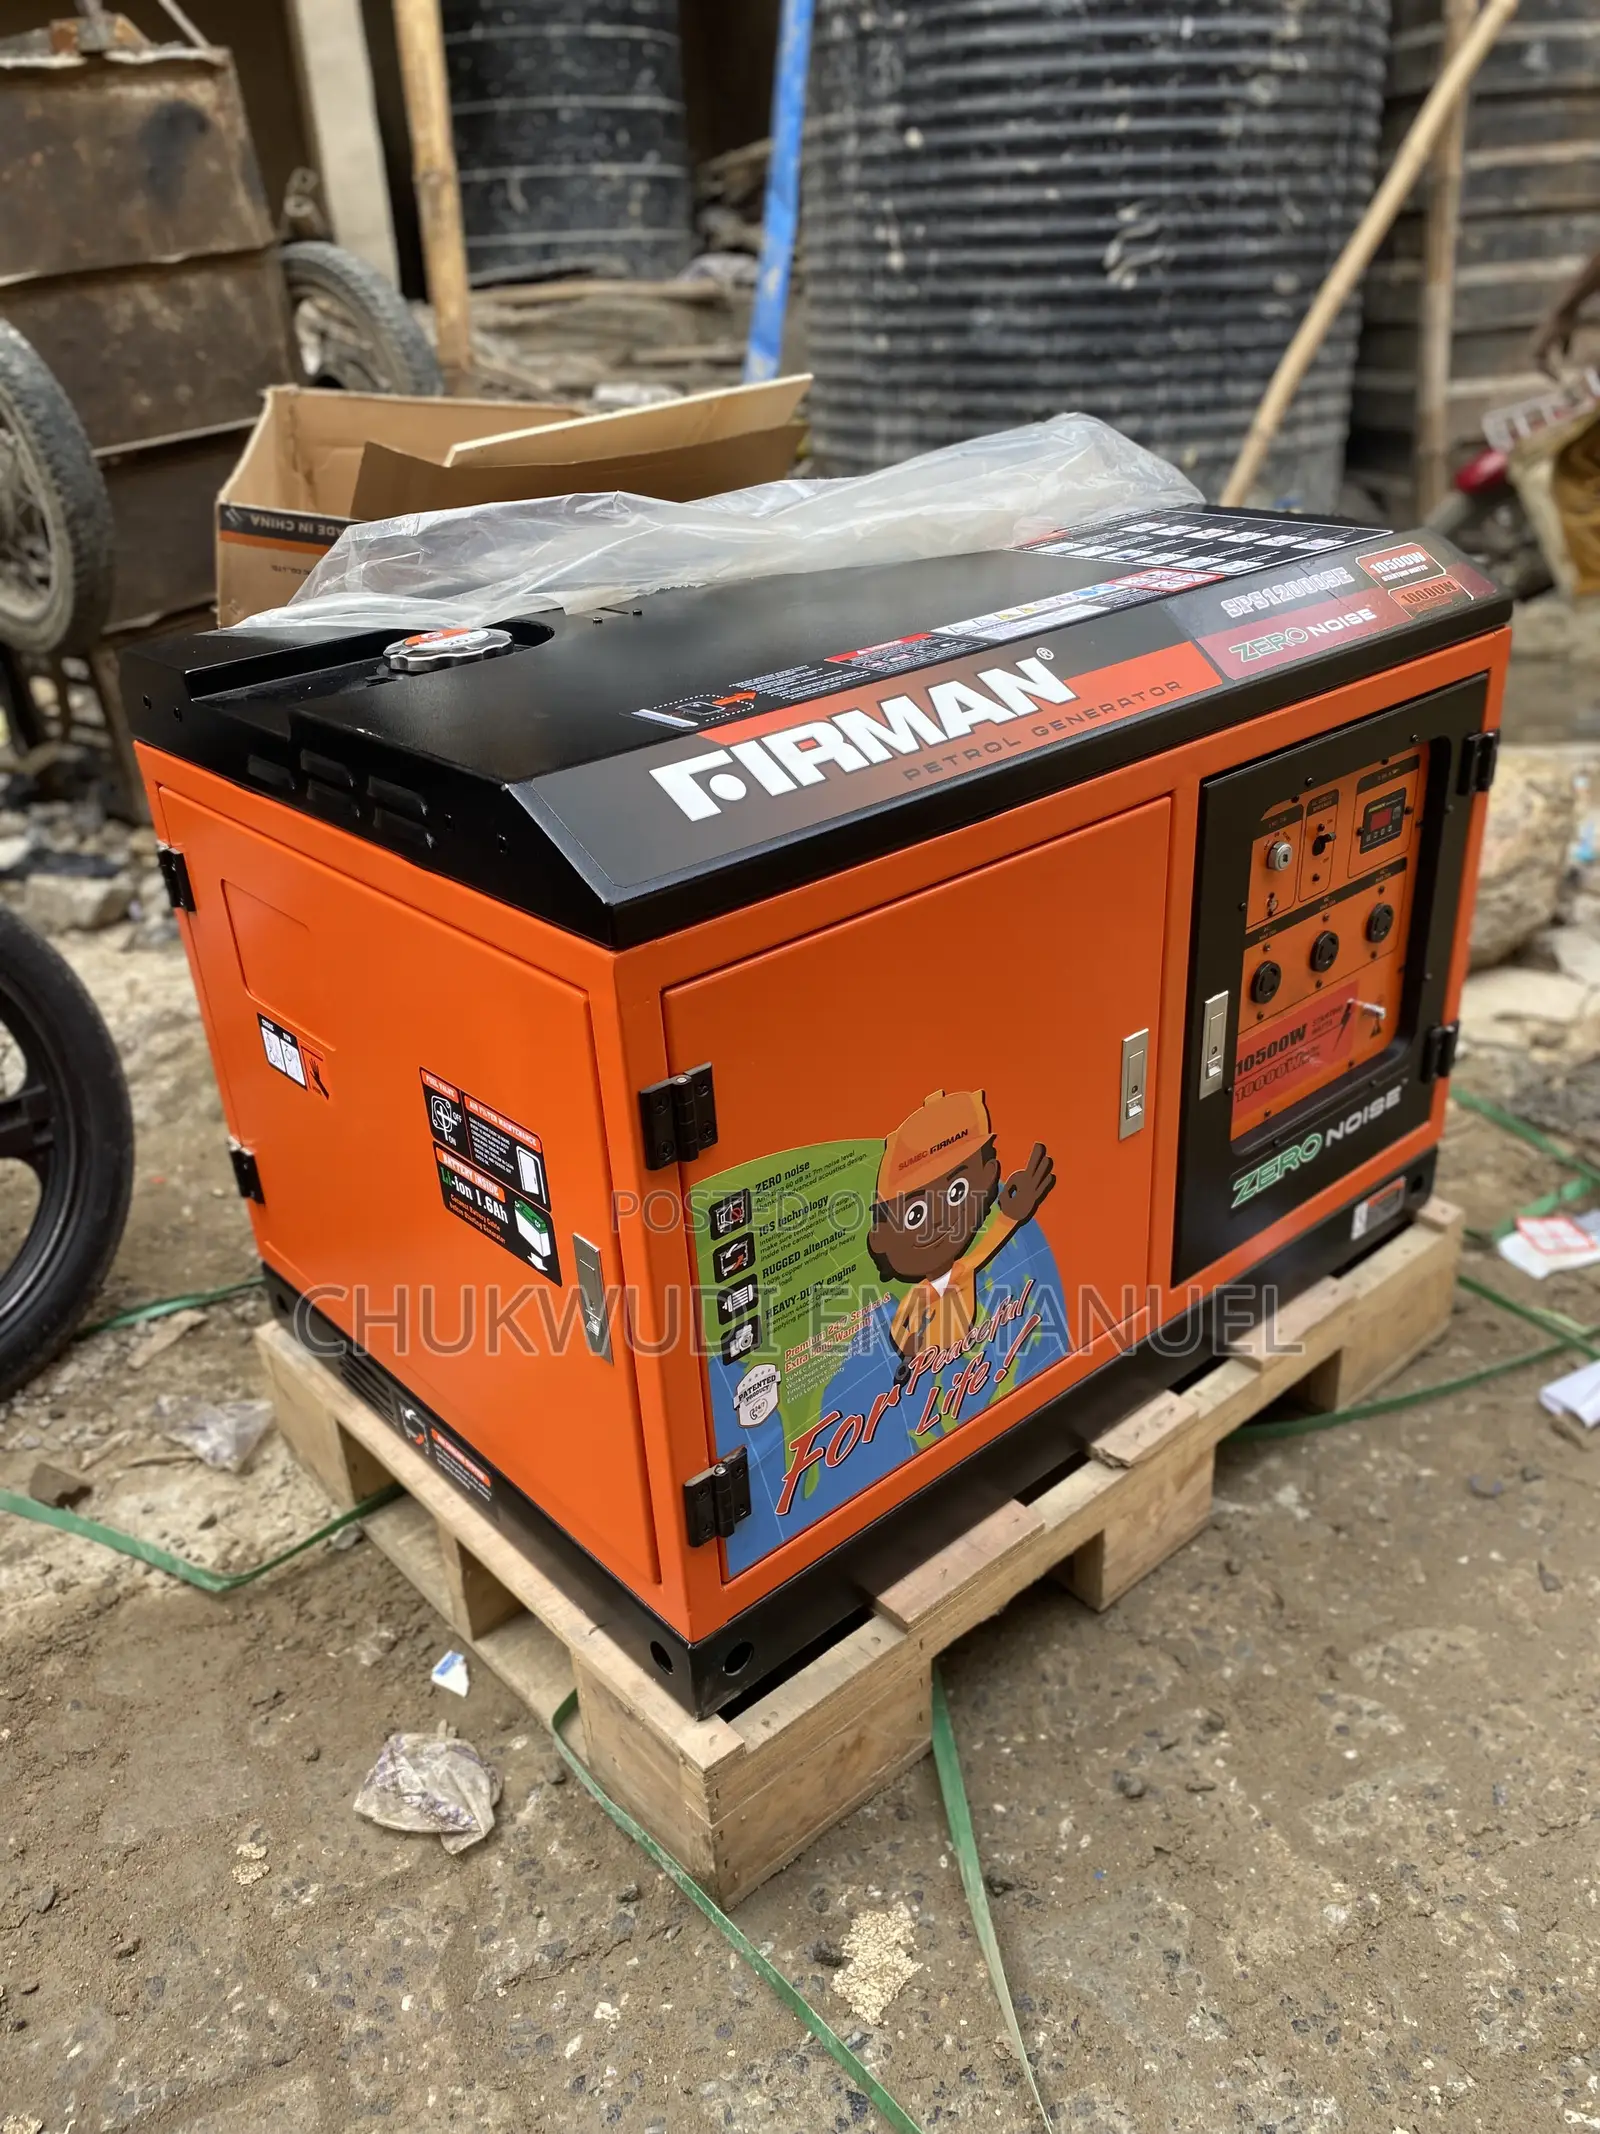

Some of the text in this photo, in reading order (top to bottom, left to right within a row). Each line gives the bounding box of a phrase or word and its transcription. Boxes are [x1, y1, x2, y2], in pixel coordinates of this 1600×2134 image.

[249, 514, 347, 536] ADE IN CHINA
[1369, 552, 1426, 574] 10500W
[1220, 566, 1355, 619] SPS12000SE
[1400, 581, 1457, 604] 10000W
[1228, 608, 1377, 663] ZERO NOISE
[900, 680, 1184, 785] PETROL GENERATOR
[1235, 1023, 1307, 1077] 10500W
[452, 1111, 462, 1123] OFF
[442, 1151, 472, 1178] BATTERY
[448, 1135, 457, 1147] ON
[898, 1128, 968, 1171] SUMEC FIRMAN
[1231, 1133, 1323, 1209] ZERO
[1325, 1085, 1402, 1147] NOISE
[440, 1166, 509, 1225] Li-ion 1.6Ah
[755, 1161, 810, 1194] ZERO noise
[777, 1195, 829, 1227] technology
[762, 1228, 847, 1279] RUGGED alternator
[765, 1263, 857, 1320] HEAVY-DUTY engine
[784, 1330, 827, 1361] Premium
[850, 1298, 882, 1322] Service
[882, 1291, 892, 1304] &
[784, 1353, 809, 1374] Extra
[810, 1339, 833, 1360] Long
[834, 1314, 874, 1344] Warranty
[738, 1374, 777, 1402] PATENTED
[745, 1385, 770, 1402] PRODUCT
[775, 1278, 1035, 1515] For Peaceful
